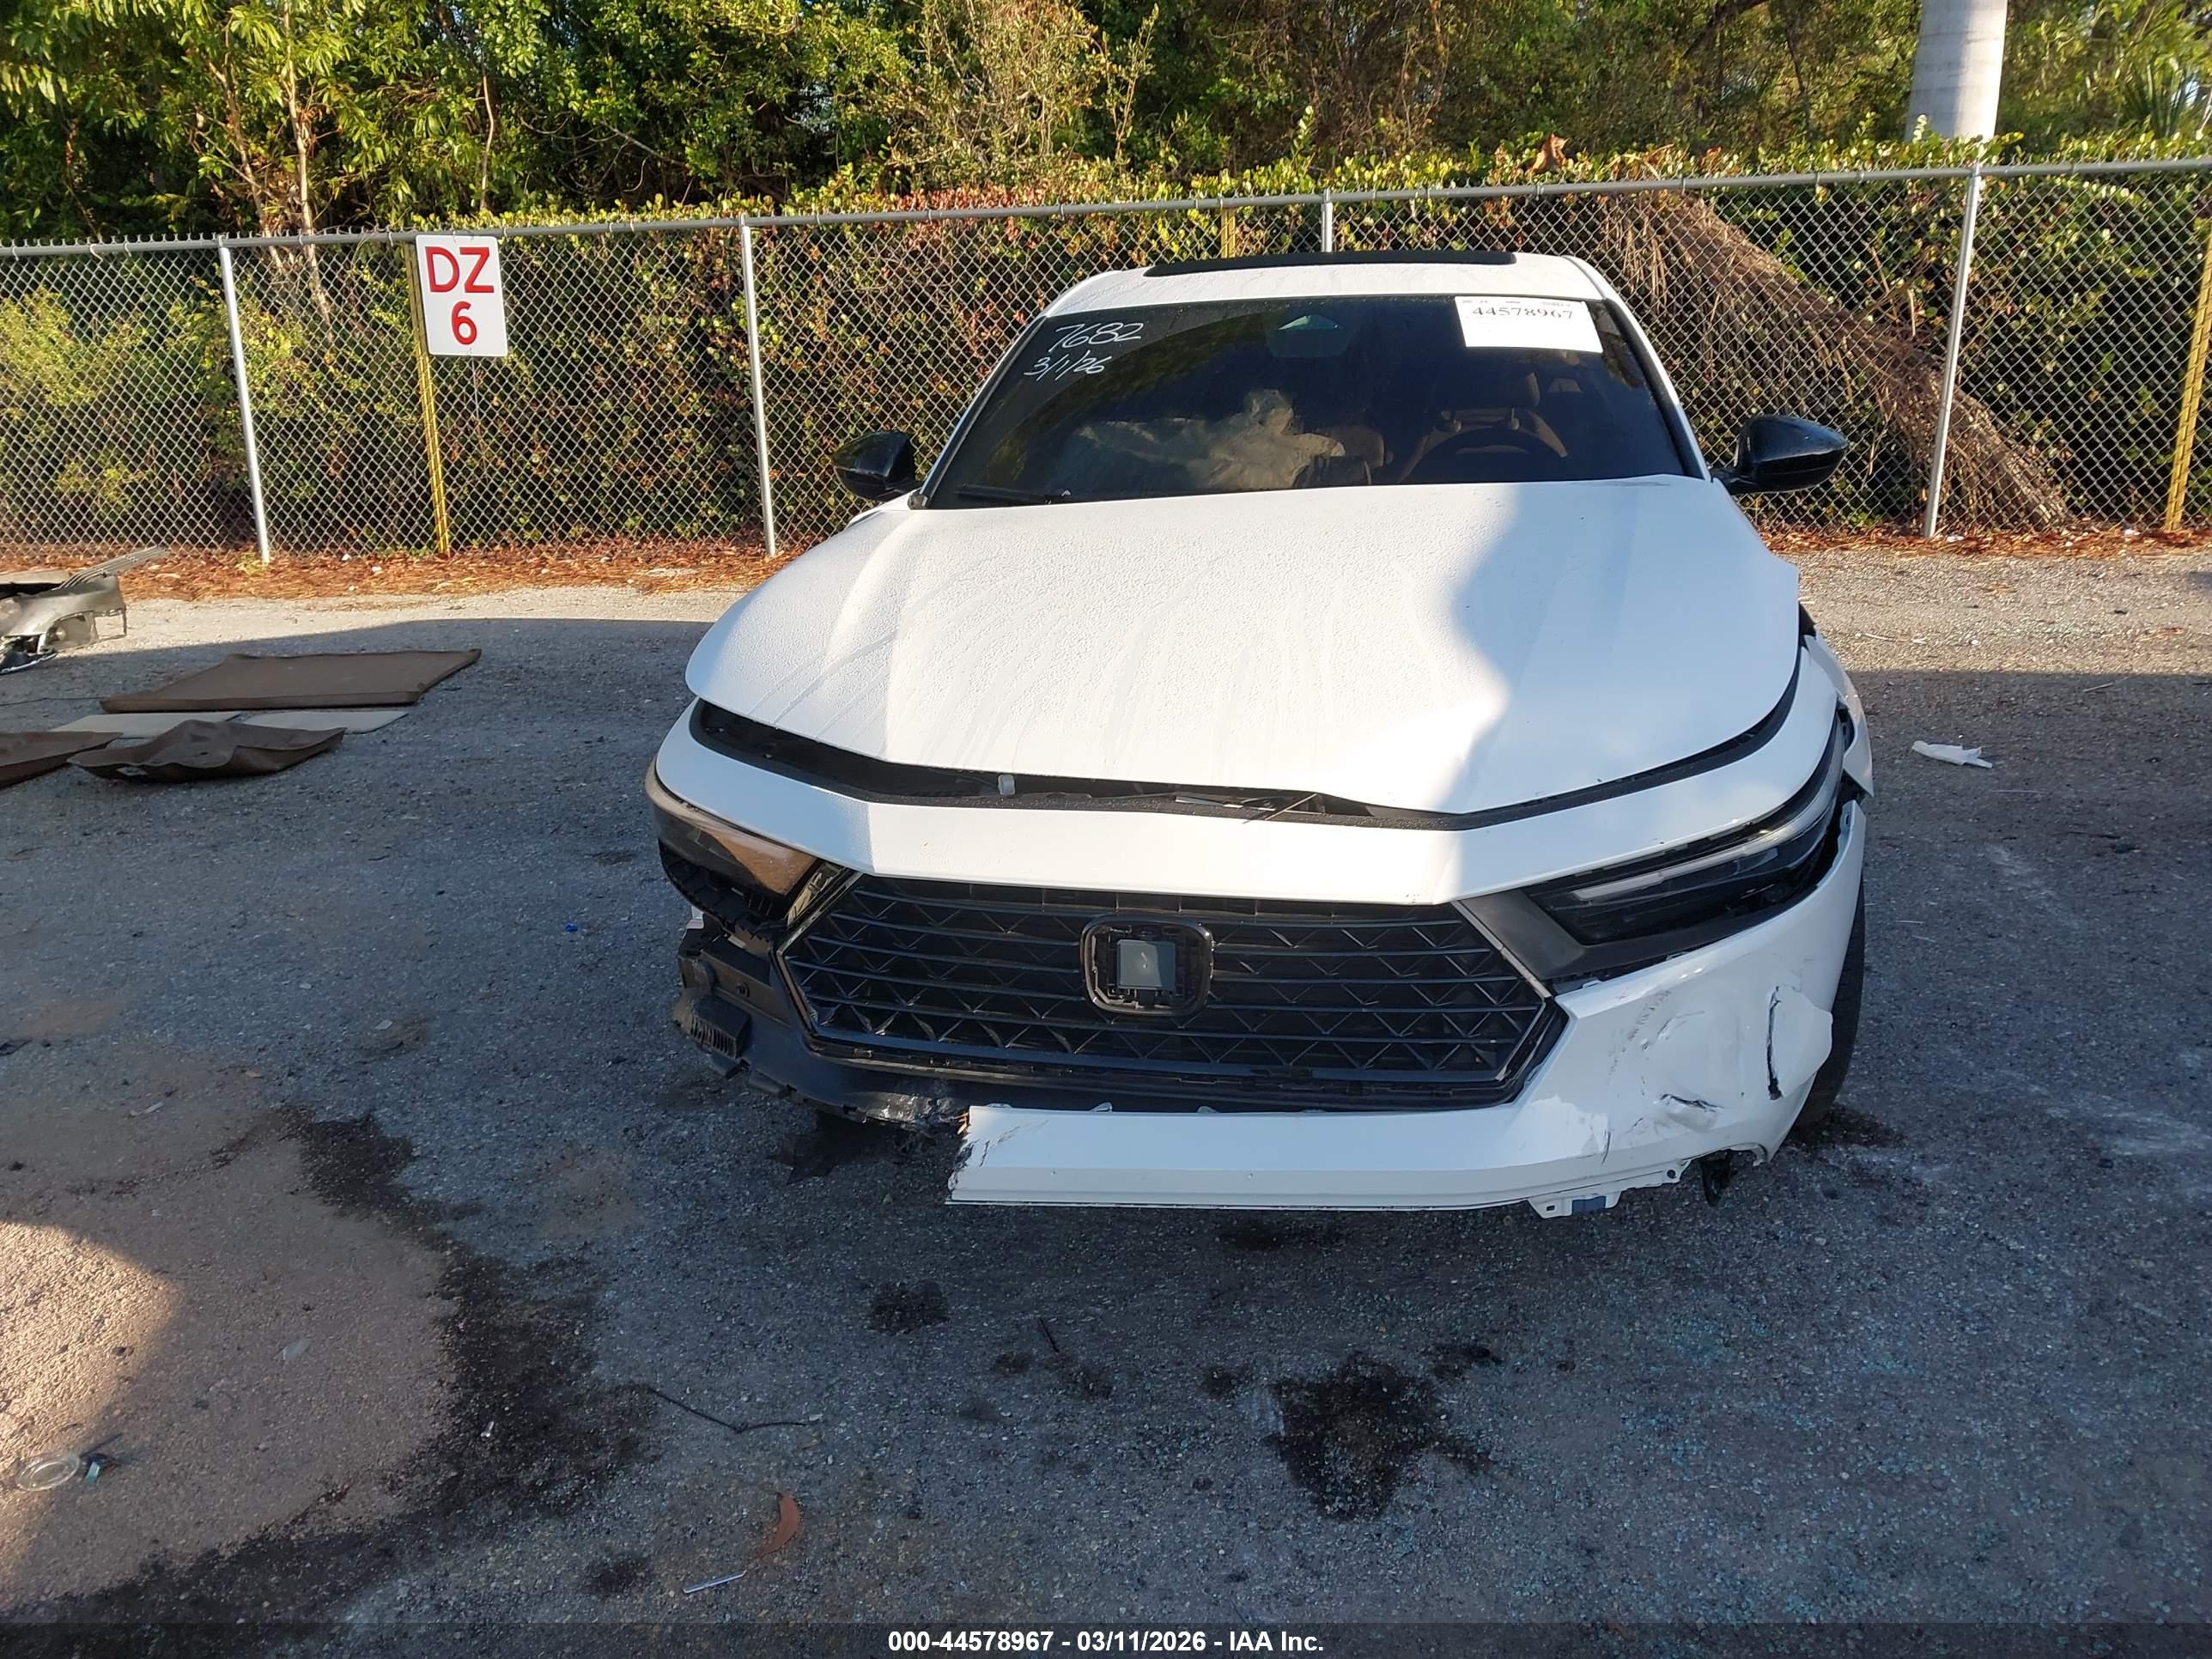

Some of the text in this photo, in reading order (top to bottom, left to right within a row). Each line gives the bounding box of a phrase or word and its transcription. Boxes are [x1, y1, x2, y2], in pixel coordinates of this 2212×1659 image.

[424, 246, 495, 294] DZ
[451, 301, 477, 345] 6
[1472, 307, 1573, 320] 44578967
[1048, 322, 1144, 353] 7682
[1023, 349, 1112, 381] 3/1/26
